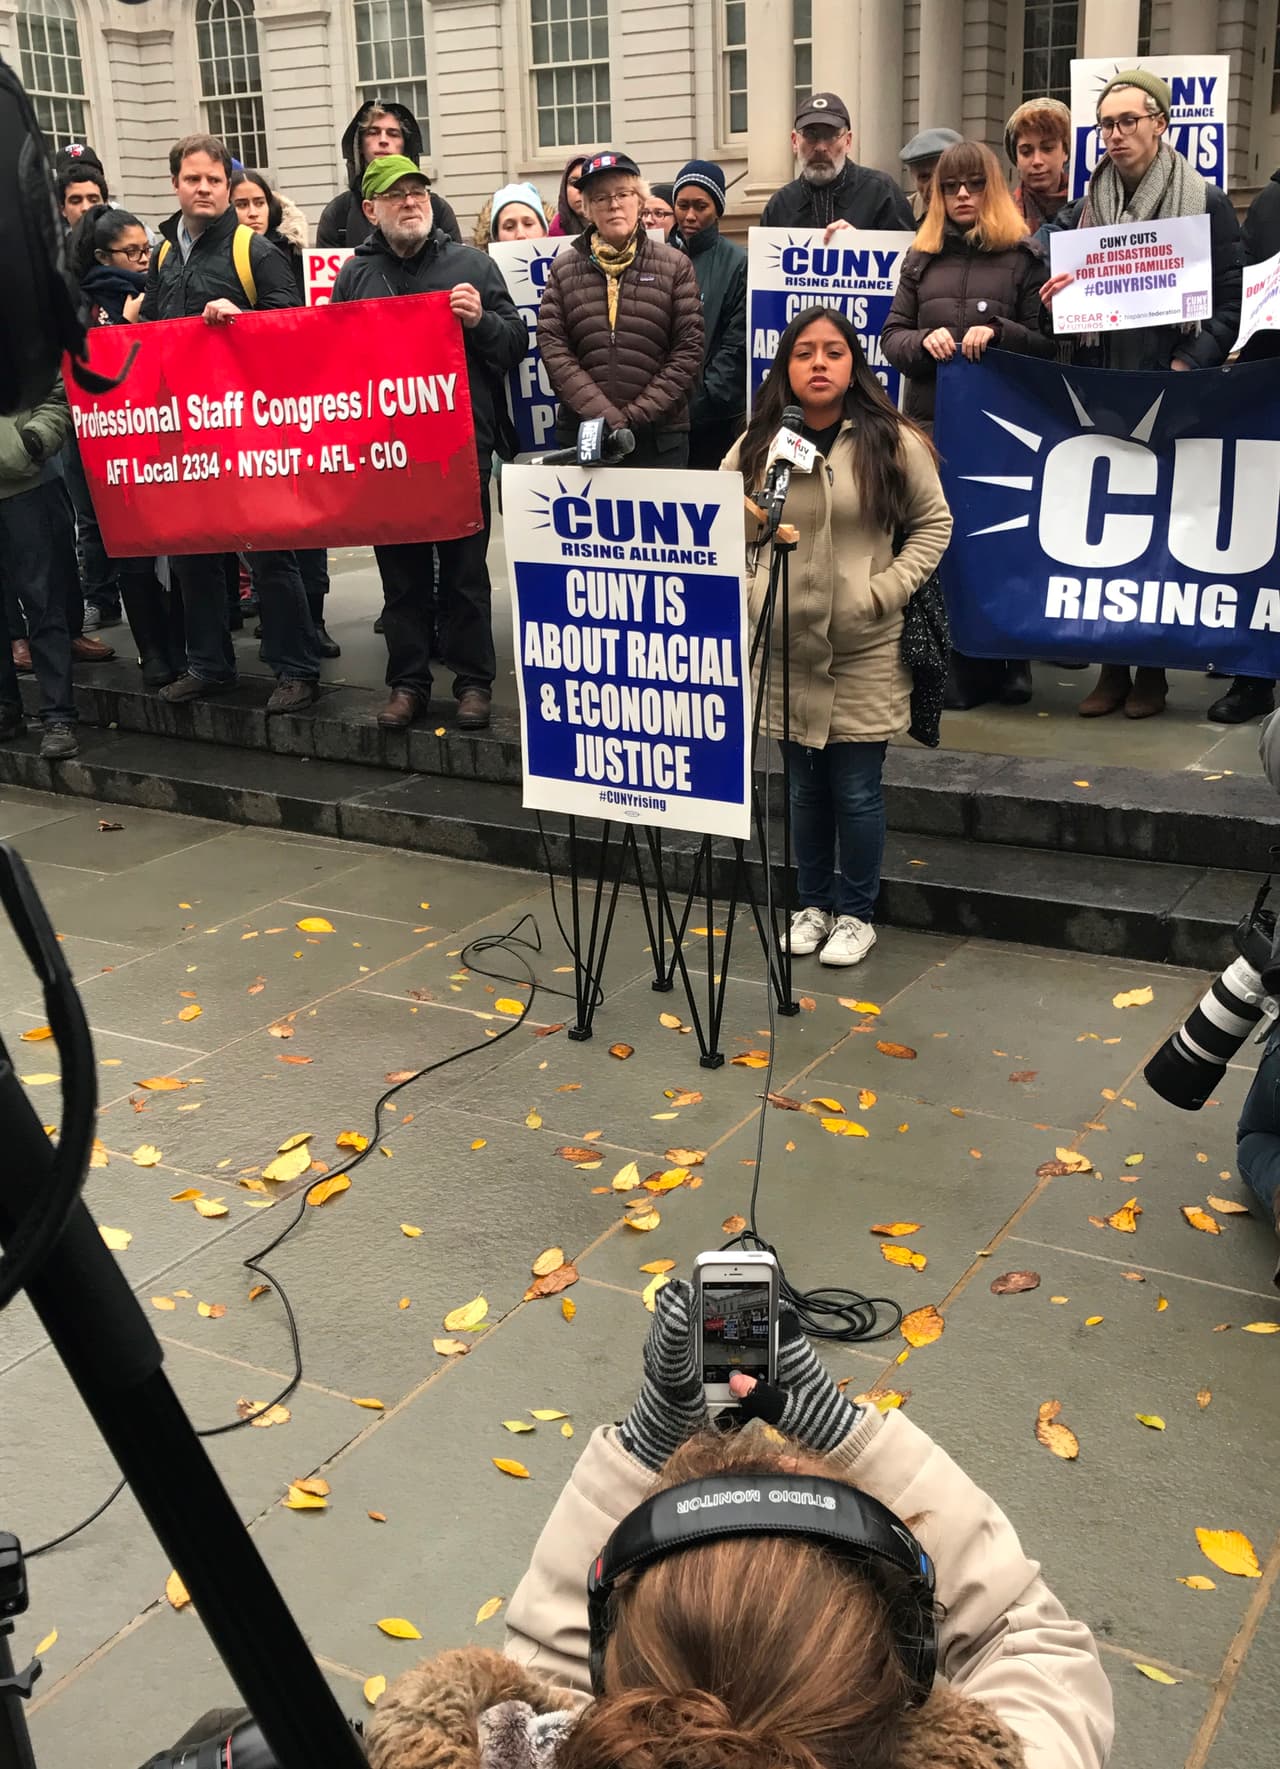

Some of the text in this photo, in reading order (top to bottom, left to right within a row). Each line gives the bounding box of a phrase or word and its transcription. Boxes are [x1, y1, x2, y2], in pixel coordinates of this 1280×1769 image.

[1170, 107, 1214, 118] LLIANCE
[1187, 125, 1217, 169] IS
[1086, 244, 1173, 265] ARE DISASTROUS
[1100, 232, 1157, 249] CUNY CUTS
[309, 255, 355, 281] PS
[782, 246, 900, 278] CUNY
[1076, 257, 1184, 280] FOR LATINO FAMILIES!
[785, 277, 893, 290] RISING ALLIANCE
[1084, 273, 1177, 296] #CUNYRISING
[846, 296, 869, 329] IS
[1066, 313, 1102, 323] CREAR
[72, 396, 182, 439] Professional
[187, 391, 244, 430] Staff
[252, 390, 363, 433] Congress
[378, 373, 457, 417] CUNY
[580, 421, 592, 460] NEWS
[106, 459, 128, 485] AFT
[132, 456, 179, 484] Local
[182, 452, 220, 481] 2334
[238, 448, 301, 477] NYSUT
[552, 496, 721, 547] CUNY
[561, 542, 717, 566] RISING ALLIANCE
[566, 569, 686, 626] CUNY IS
[1045, 576, 1238, 628] RISING
[524, 621, 739, 687] ABOUT RACIAL
[540, 679, 726, 742] & ECONOMIC
[574, 733, 692, 792] JUSTICE
[599, 790, 667, 812] #CUNYrising
[676, 1489, 837, 1514] STUDIO MONITOR
